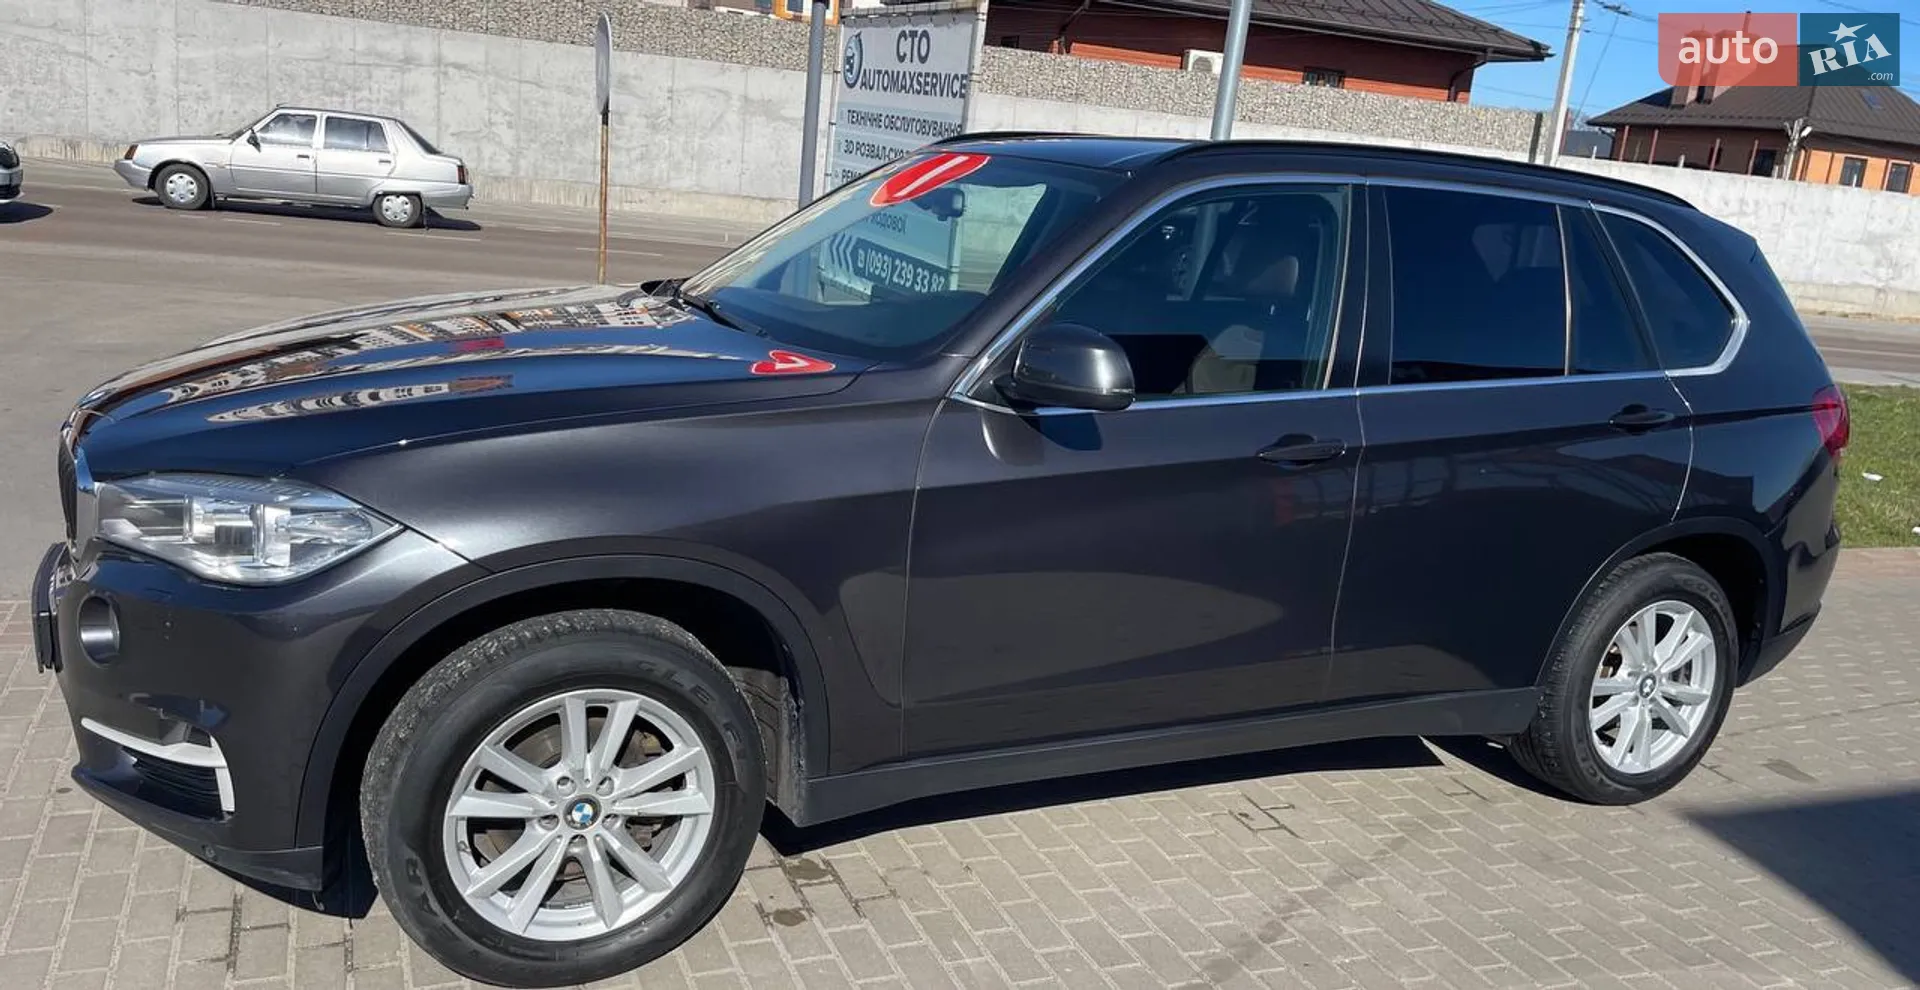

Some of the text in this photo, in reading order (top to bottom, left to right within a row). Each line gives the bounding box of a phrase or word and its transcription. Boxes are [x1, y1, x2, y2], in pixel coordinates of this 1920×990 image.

[896, 29, 931, 64] СТО
[859, 68, 969, 99] AUTOMAXSERVICE
[847, 109, 883, 129] ТЕХНІЧНЕ
[865, 248, 892, 285] (093)
[892, 259, 914, 288] 239
[914, 267, 930, 293] 33
